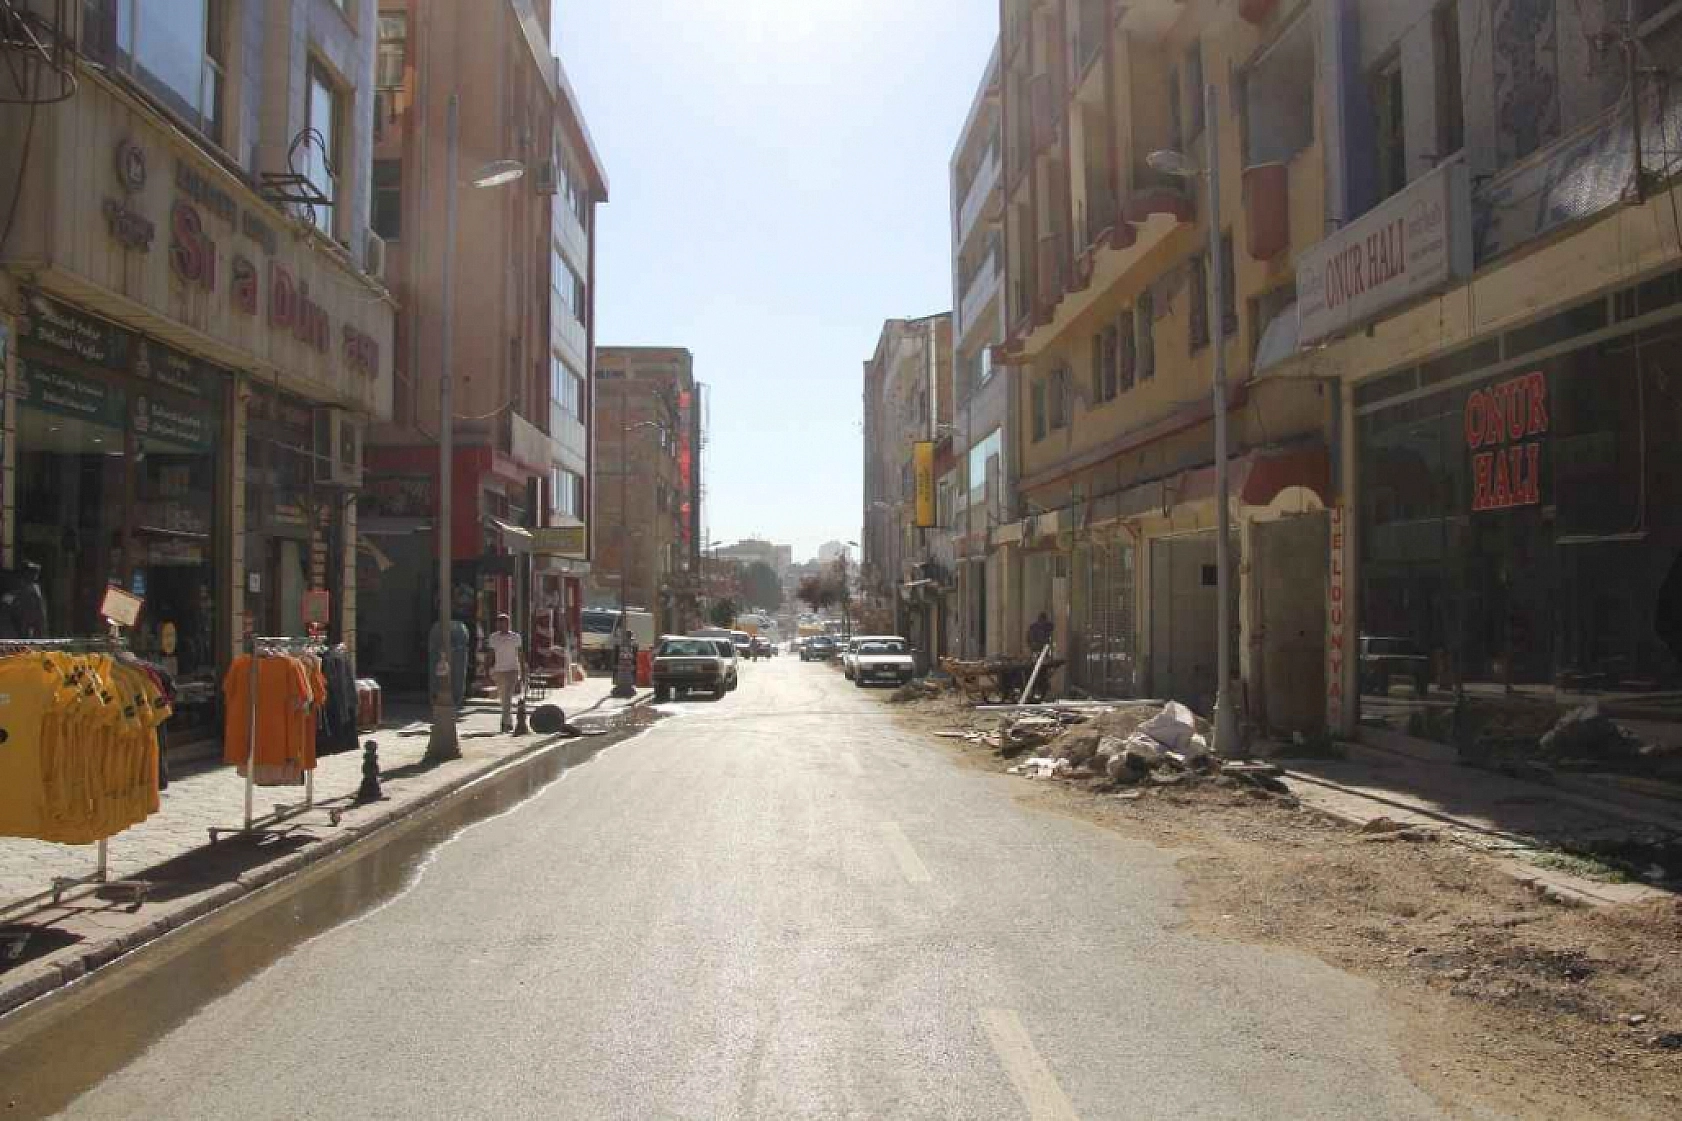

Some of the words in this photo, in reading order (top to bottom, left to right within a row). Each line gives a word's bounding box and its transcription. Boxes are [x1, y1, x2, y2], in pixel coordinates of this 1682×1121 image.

[1325, 243, 1366, 309] ONUR
[1367, 218, 1407, 289] HALI
[1464, 371, 1549, 448] ONUR
[1472, 442, 1540, 510] HALI
